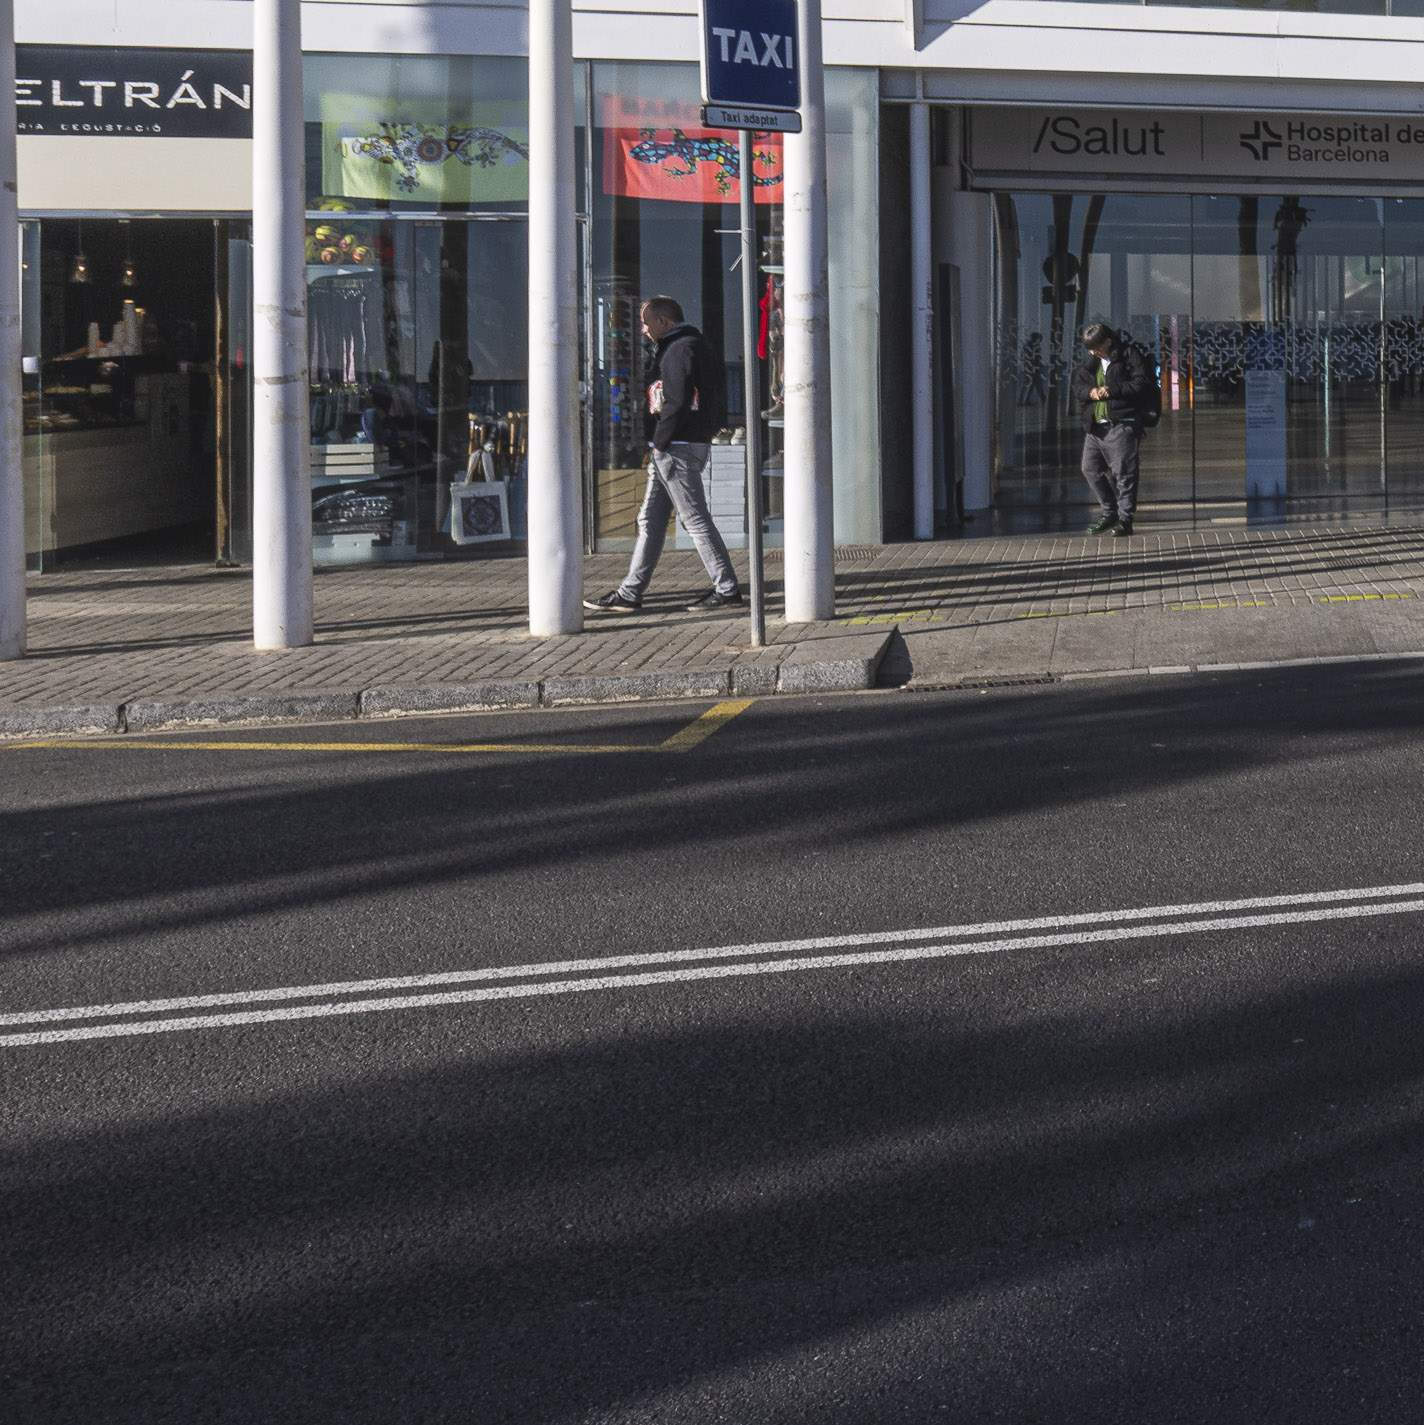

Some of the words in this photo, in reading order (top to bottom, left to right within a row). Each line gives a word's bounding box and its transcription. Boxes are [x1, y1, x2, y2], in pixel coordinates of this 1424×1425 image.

[712, 26, 793, 70] TAXI
[721, 111, 741, 123] Taxi
[744, 112, 779, 127] adaptat
[1033, 116, 1166, 156] /Salut
[1287, 121, 1391, 147] Hospital
[1287, 144, 1390, 163] Barcelona
